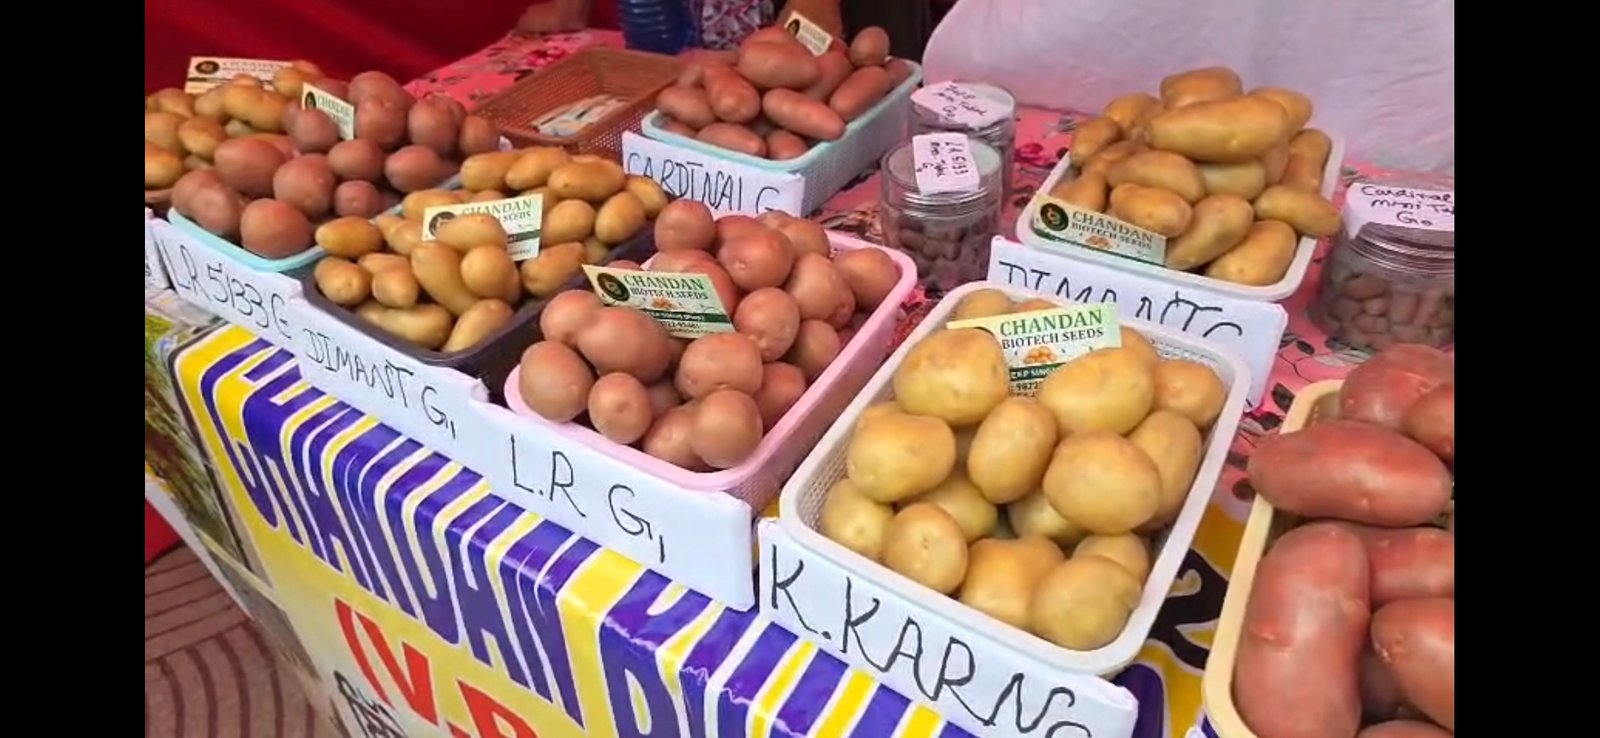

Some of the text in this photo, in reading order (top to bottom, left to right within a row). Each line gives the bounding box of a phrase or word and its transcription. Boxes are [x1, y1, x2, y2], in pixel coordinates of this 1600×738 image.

[1072, 210, 1153, 243] CHANDAN
[624, 273, 705, 291] CHANDAN
[1000, 308, 1102, 338] CHANDAN
[1001, 326, 1105, 351] BIOTECH SEEDS
[302, 327, 414, 409] DIMANT
[201, 337, 585, 730] CHANDAN
